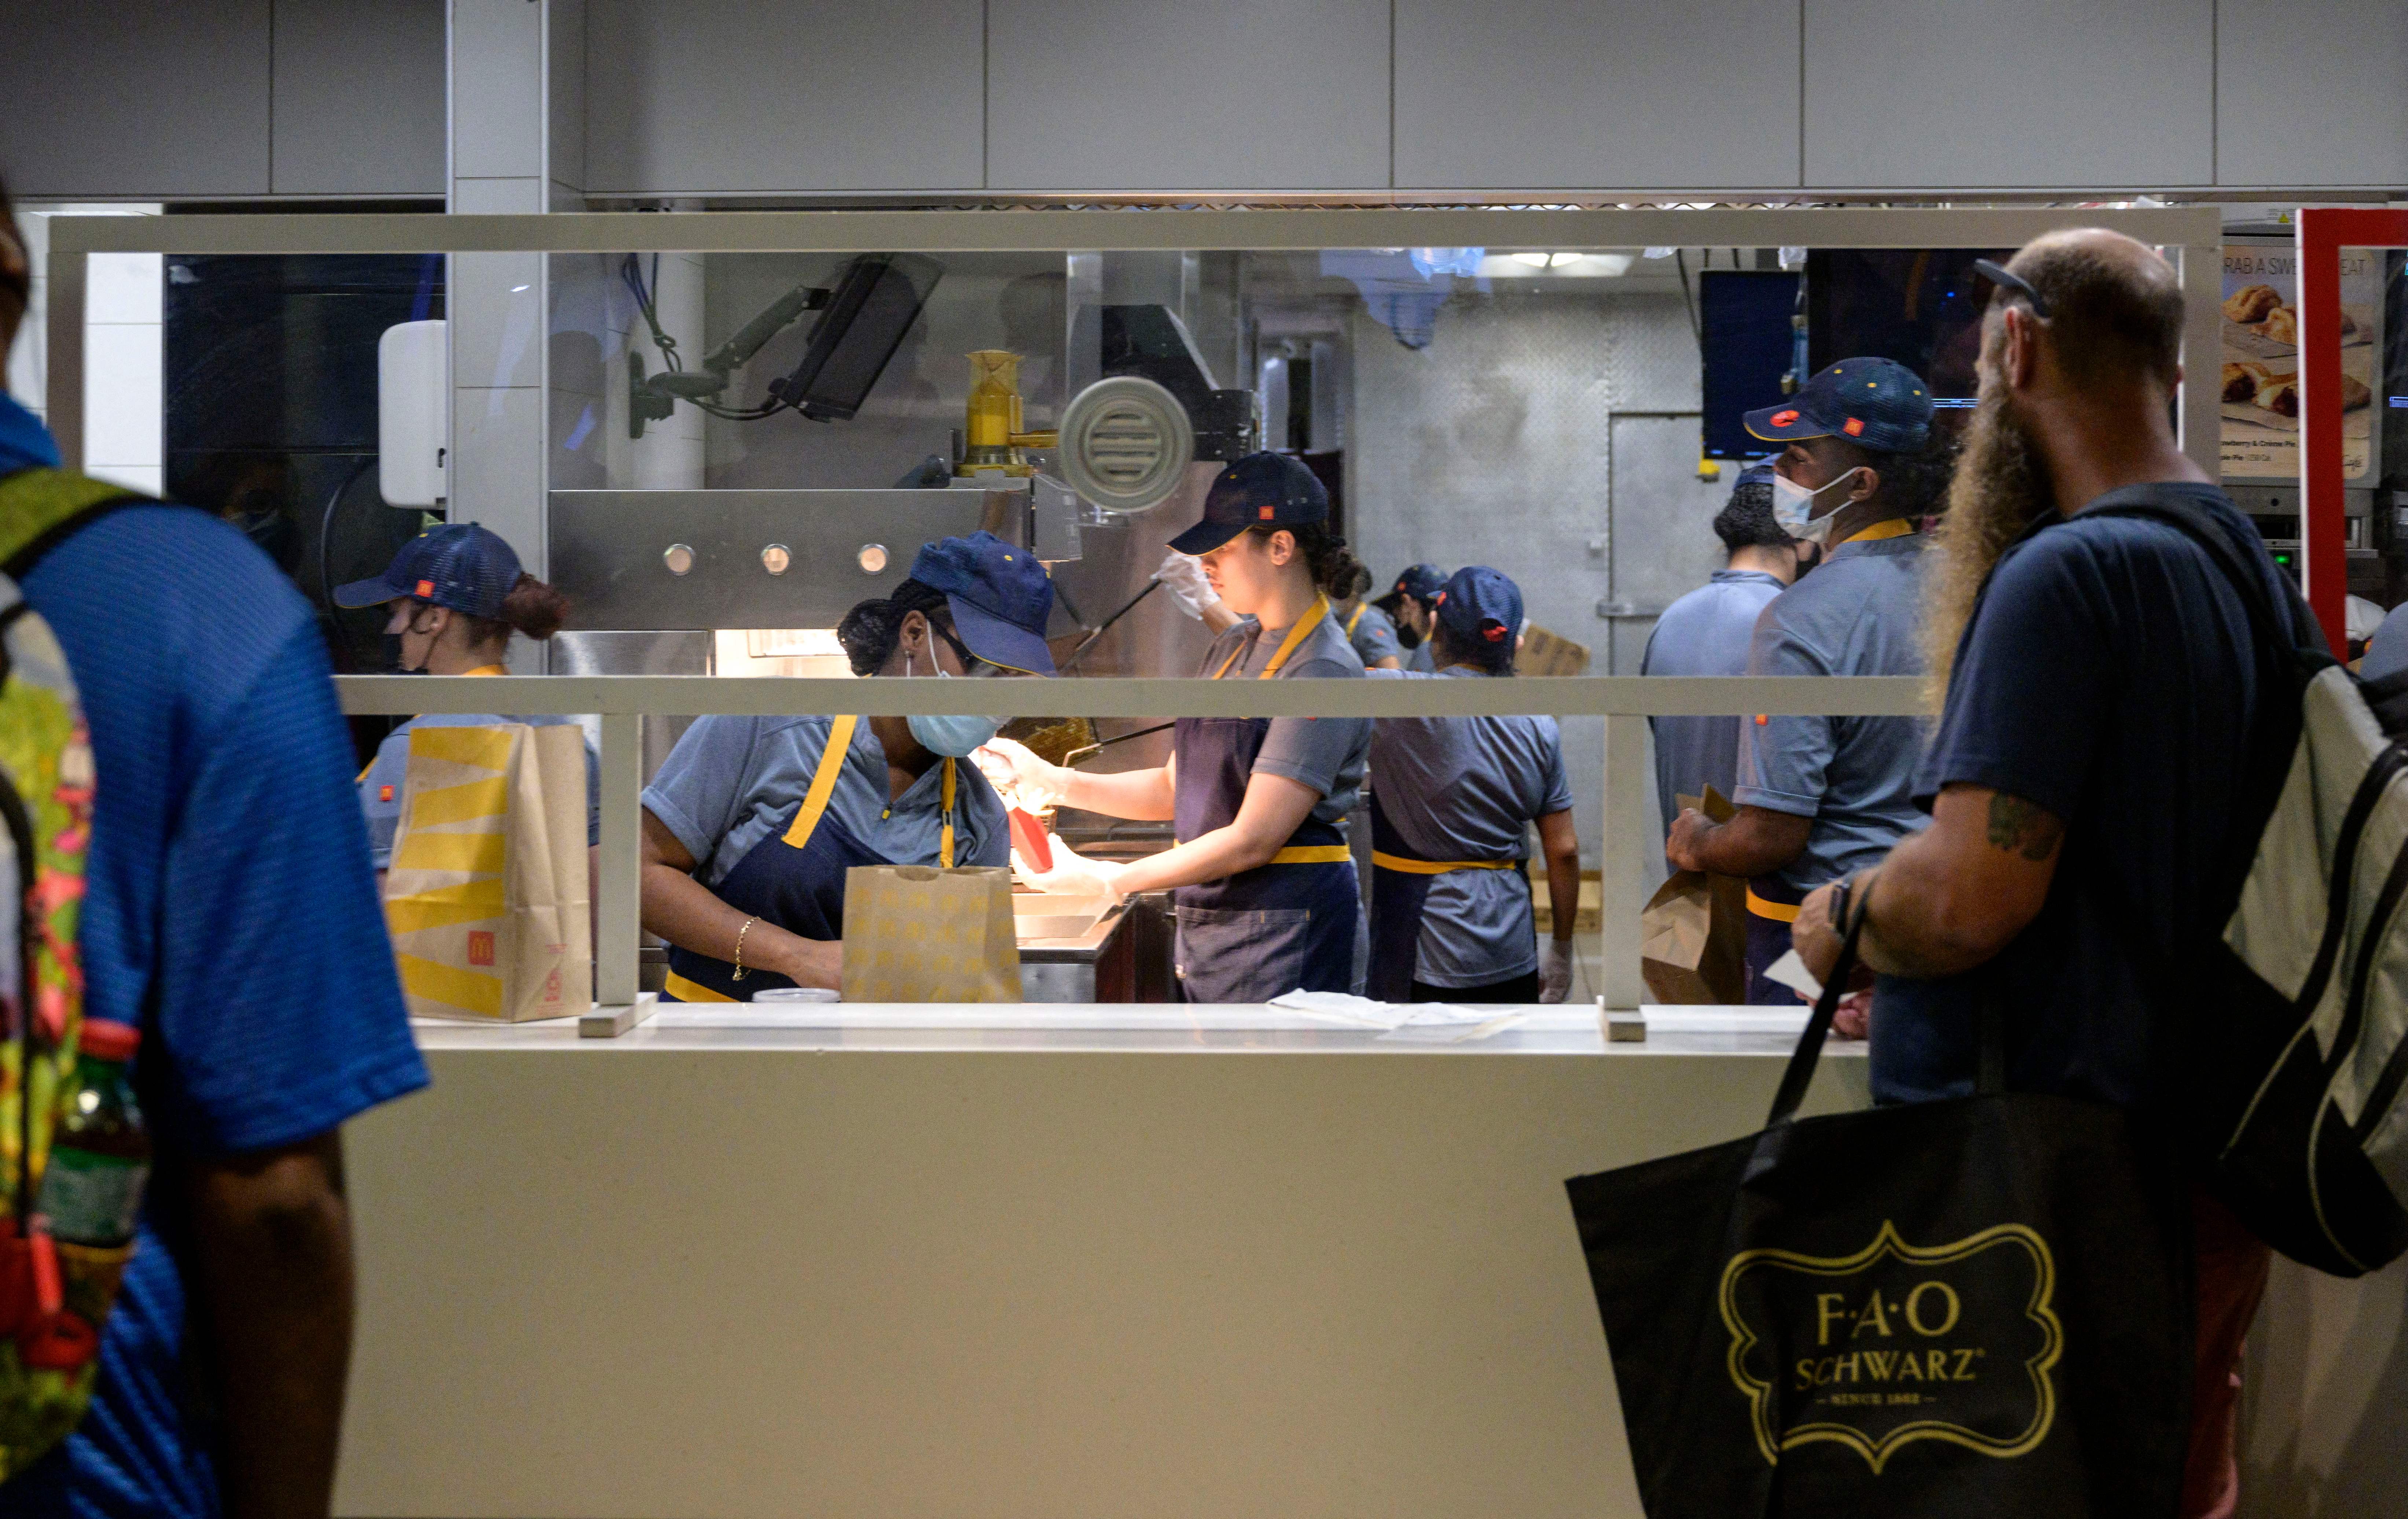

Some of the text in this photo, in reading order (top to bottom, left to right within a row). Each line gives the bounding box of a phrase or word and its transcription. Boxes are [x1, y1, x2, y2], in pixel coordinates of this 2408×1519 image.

[2223, 257, 2253, 274] RAB
[2268, 257, 2297, 275] SWE
[2341, 259, 2365, 275] EAT
[1796, 1349, 1976, 1391] SCHWARZ
